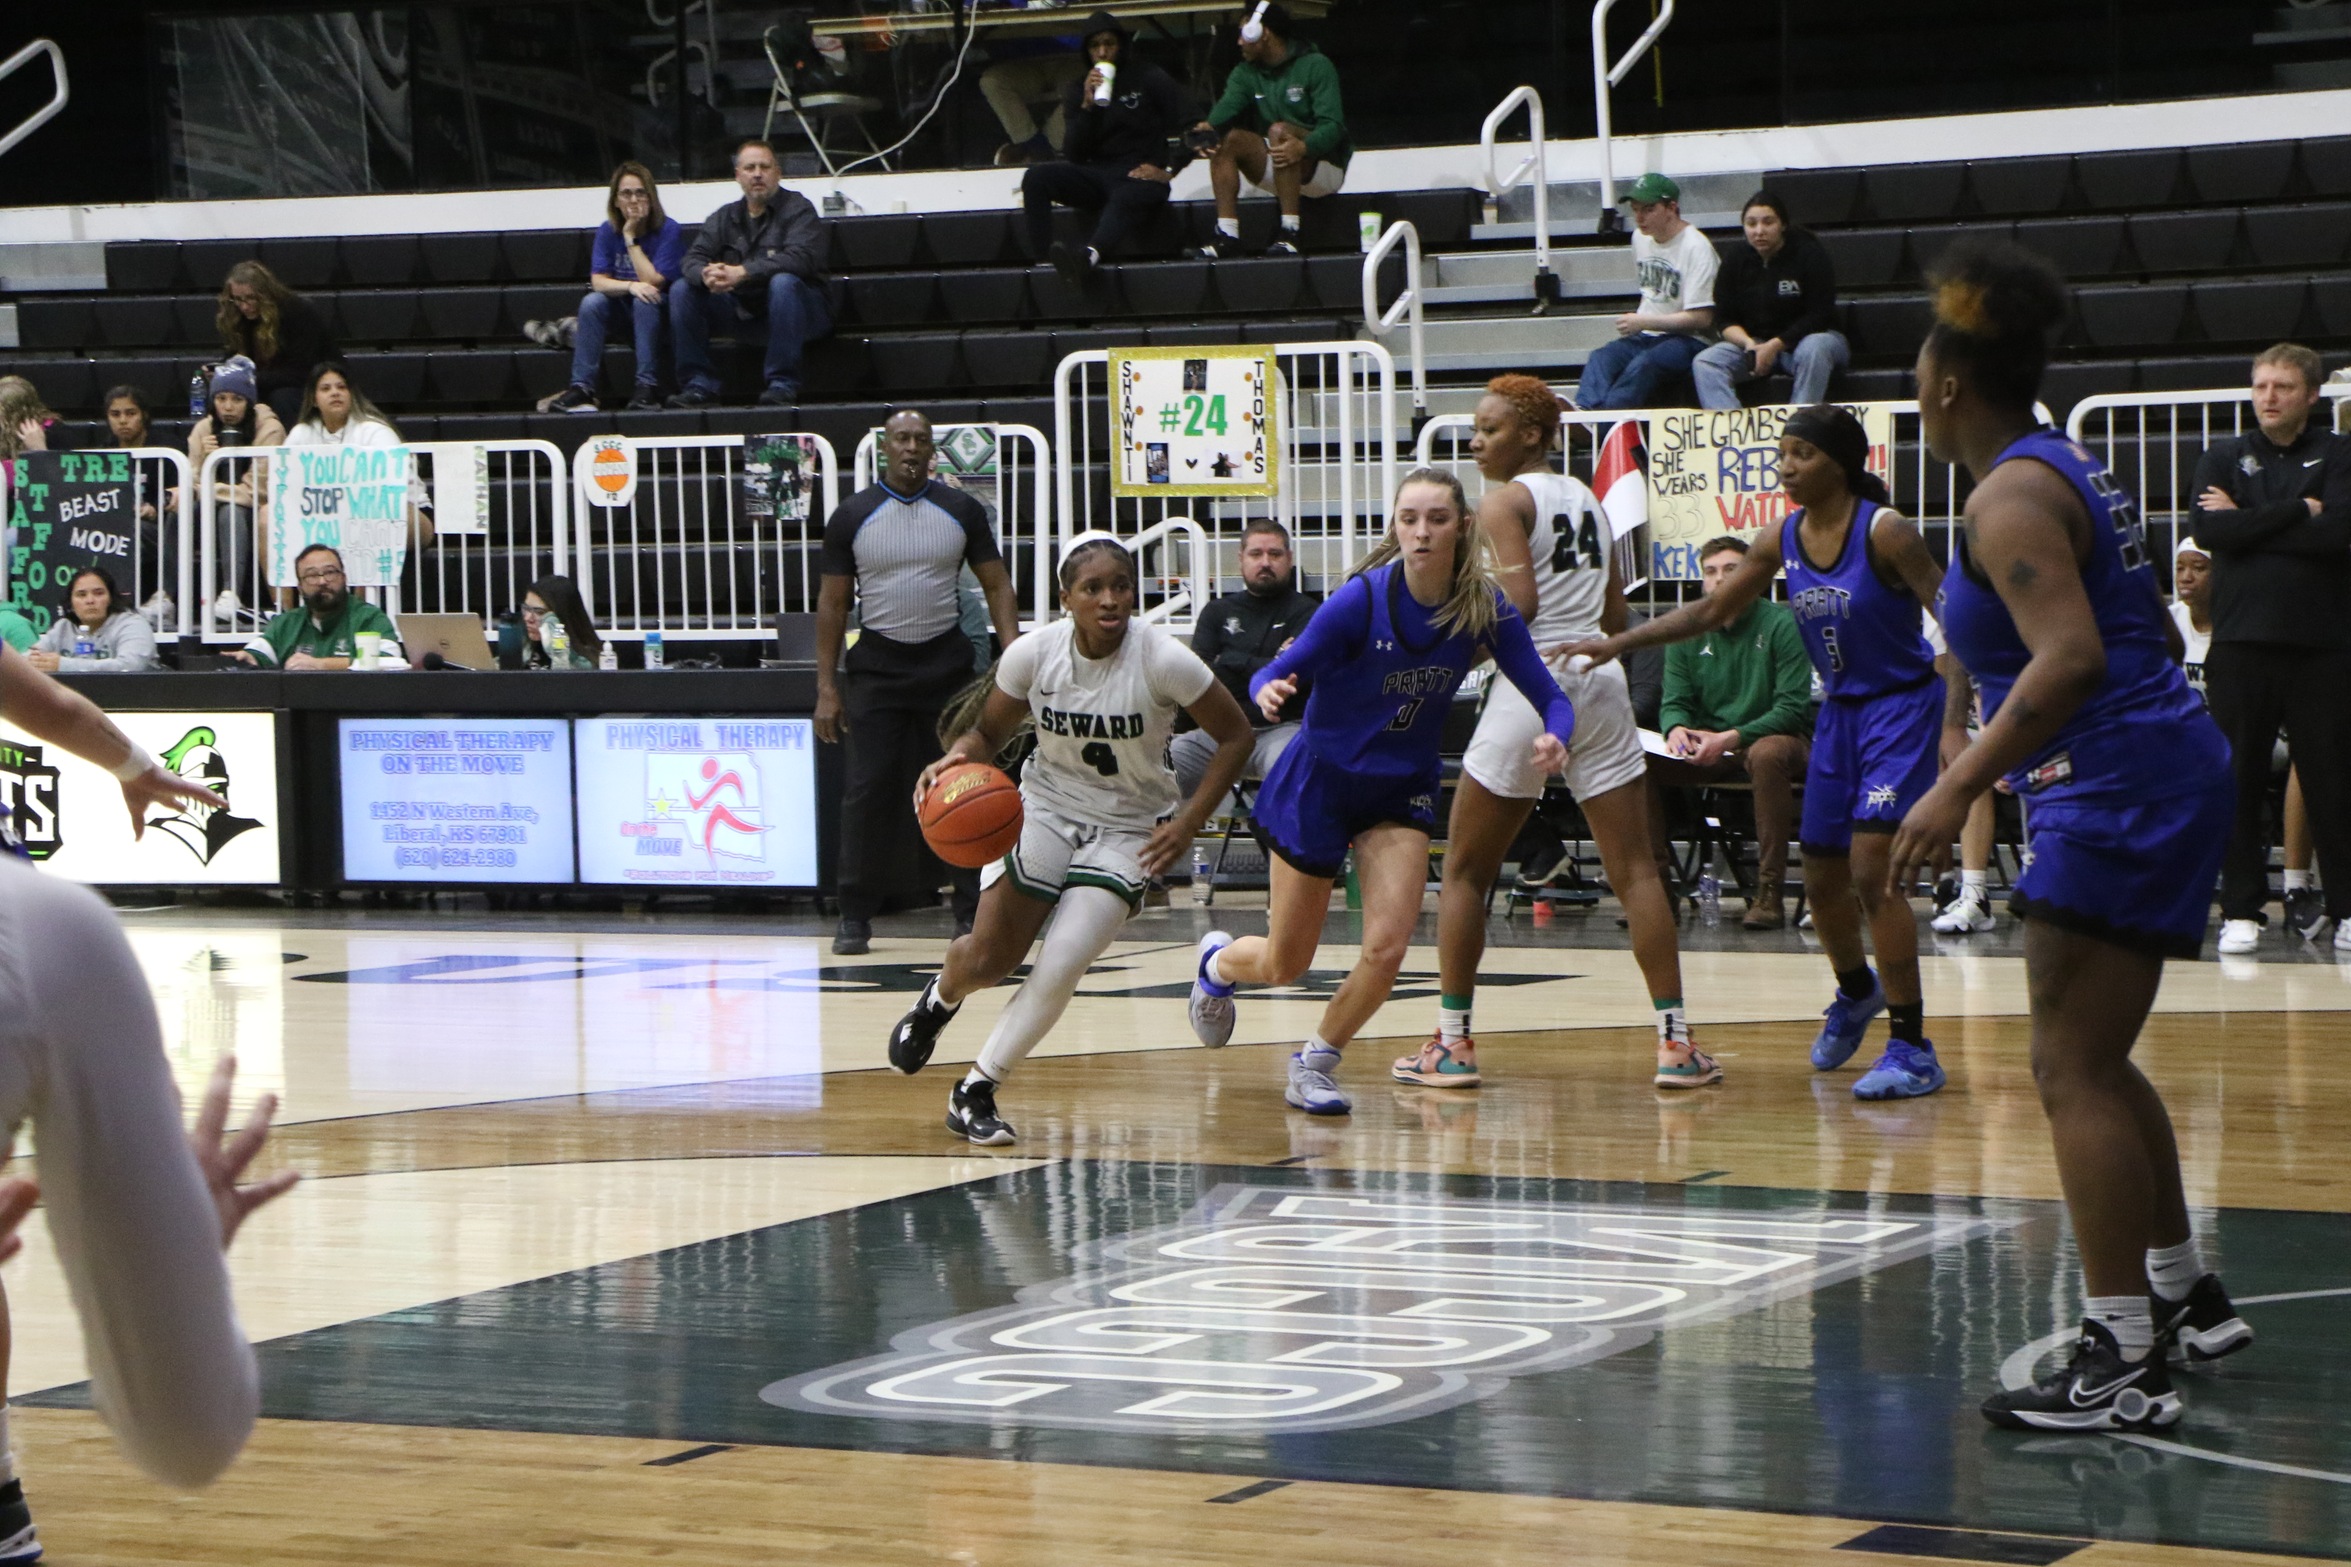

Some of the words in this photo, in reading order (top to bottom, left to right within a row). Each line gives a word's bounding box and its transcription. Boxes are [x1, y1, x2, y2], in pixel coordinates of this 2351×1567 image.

[1121, 361, 1135, 481] SHAWNTI
[1159, 394, 1228, 437] #24
[1252, 361, 1265, 474] THOMAS
[1664, 413, 1706, 451] SHE
[60, 454, 130, 482] TRE
[299, 451, 338, 485] YOU
[1653, 451, 1685, 478] SHE
[474, 445, 488, 529] NATHAN
[1652, 473, 1708, 495] WEARS
[59, 489, 120, 522] BEAST
[300, 487, 344, 516] STOP
[345, 485, 408, 519] WHAT
[1657, 494, 1705, 540] 33
[70, 527, 130, 556] MODE
[1551, 511, 1603, 574] 24
[1382, 666, 1454, 696] PRATT
[606, 723, 702, 749] PHYSICAL
[716, 723, 806, 749] THERAPY
[1041, 706, 1144, 740] SEWARD
[350, 731, 450, 751] PHYSICAL
[455, 731, 554, 751] THERAPY
[382, 754, 411, 774] ON
[417, 754, 457, 774] THE
[461, 754, 524, 774] MOVE
[412, 803, 426, 819] N
[427, 803, 496, 820] Western
[383, 825, 448, 846] Liberal,
[449, 827, 475, 844] KS
[477, 827, 527, 844] 67901
[635, 838, 682, 856] MOVE
[394, 846, 438, 870] (620)
